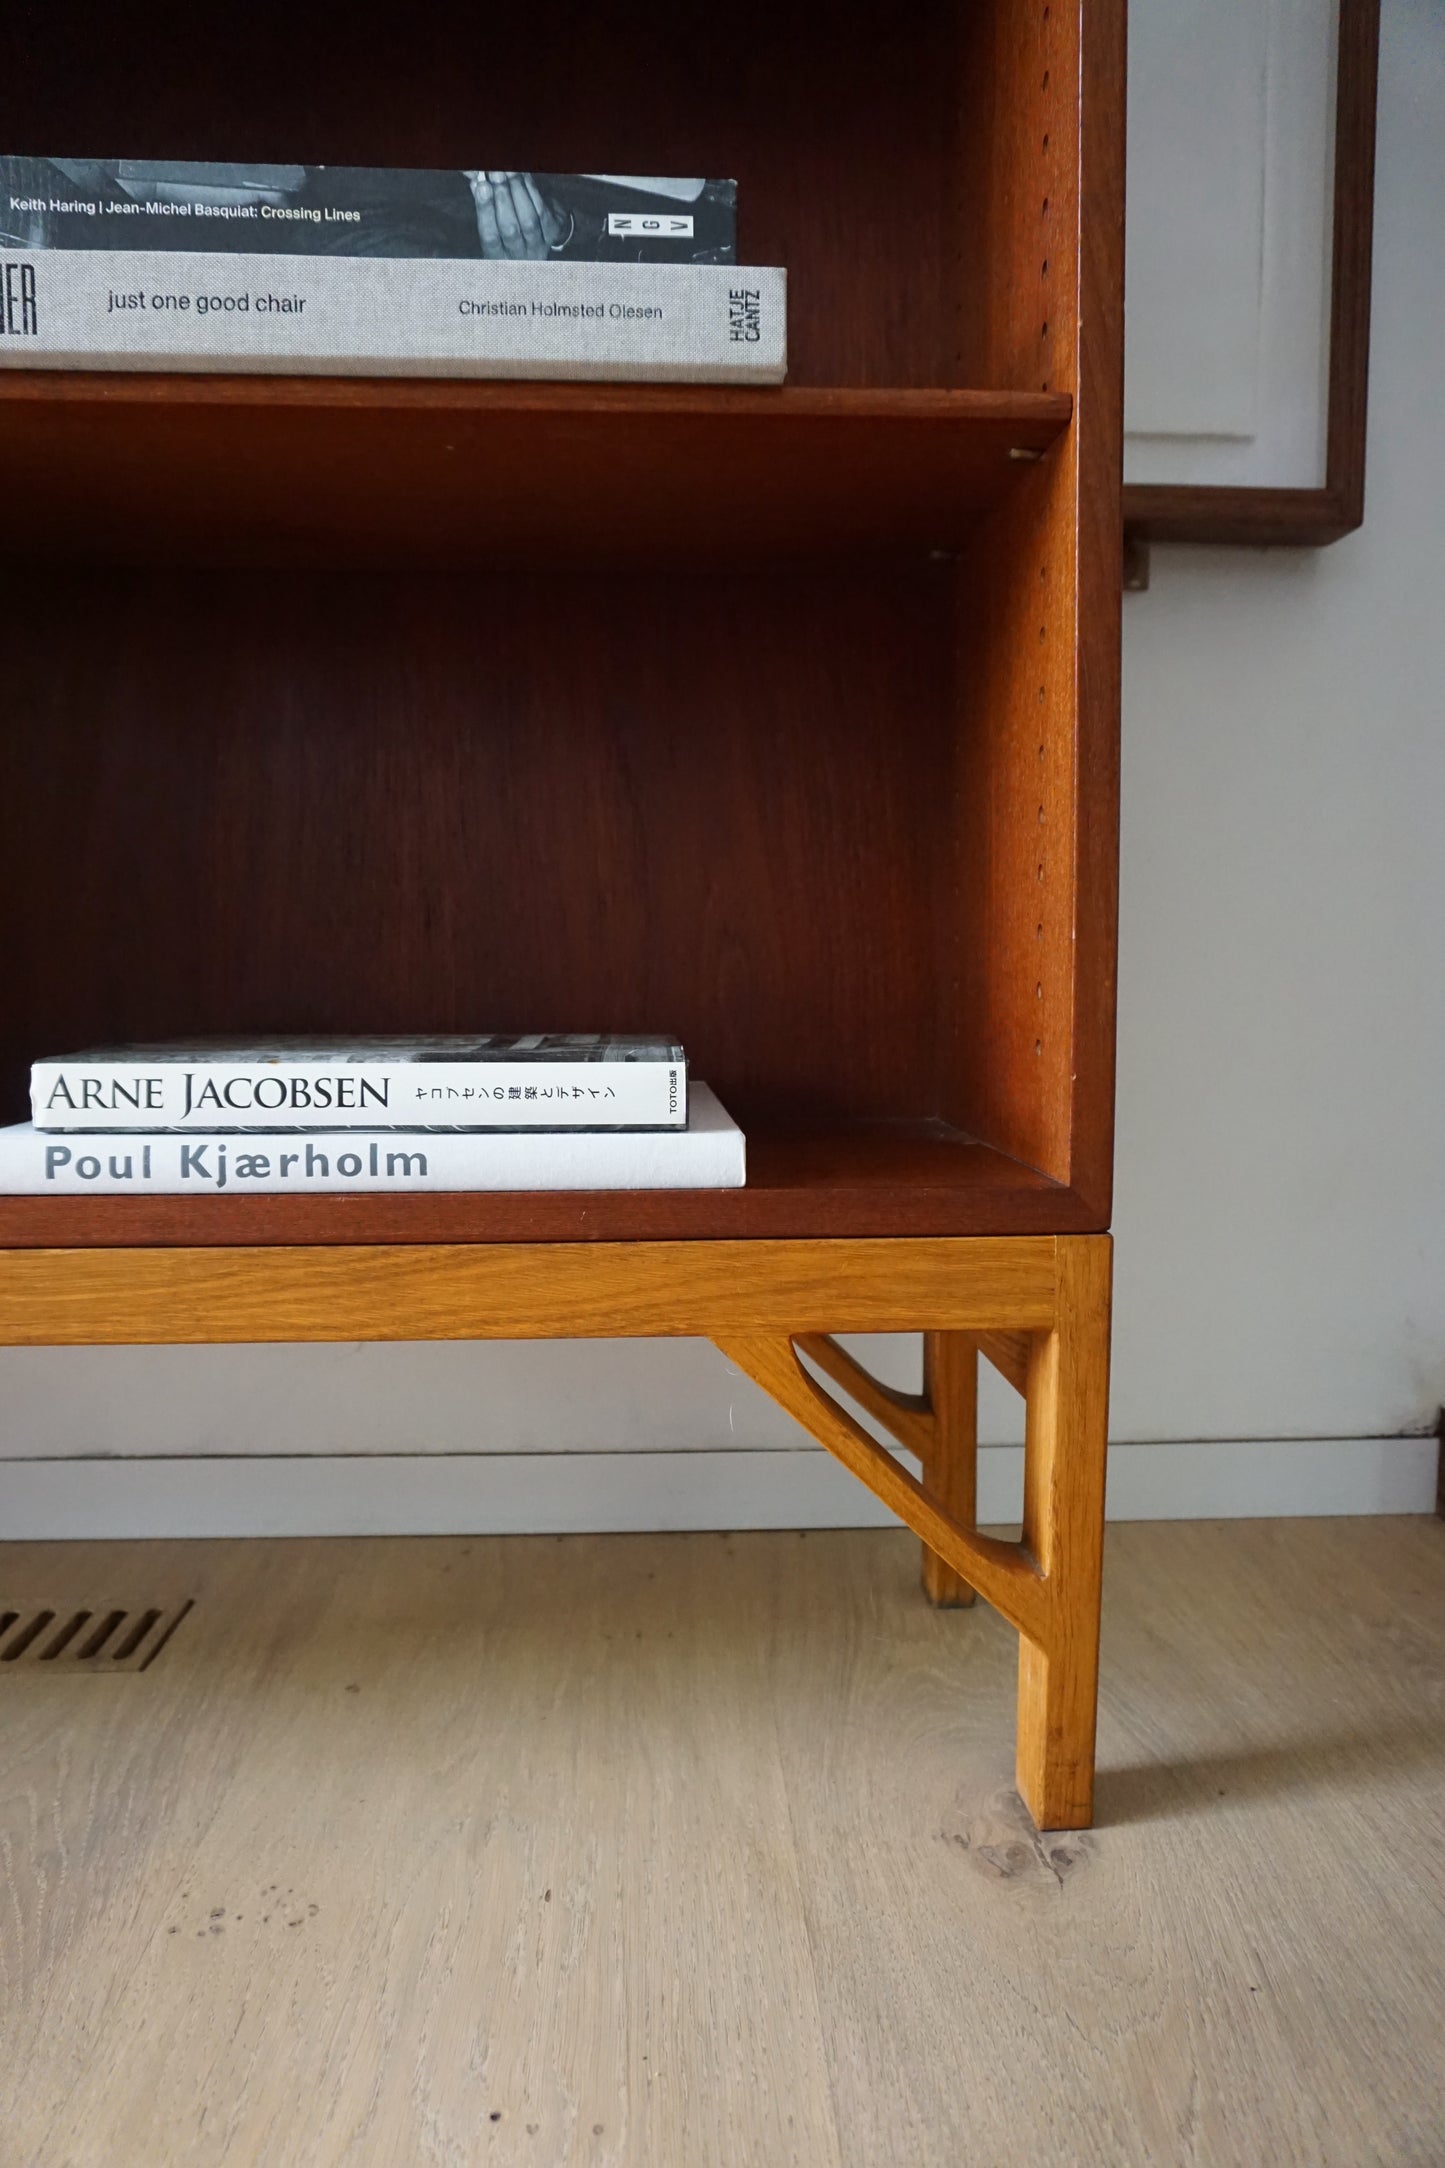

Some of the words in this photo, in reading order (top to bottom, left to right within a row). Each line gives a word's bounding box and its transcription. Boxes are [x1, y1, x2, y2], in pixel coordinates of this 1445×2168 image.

[10, 197, 46, 212] Keith
[50, 199, 96, 216] Haring
[105, 201, 192, 216] Jean-Michel
[194, 203, 258, 219] Basquiat:
[261, 206, 322, 222] Crossing
[324, 208, 361, 222] Lines
[107, 290, 147, 312] just
[151, 295, 192, 311] one
[196, 293, 250, 314] good
[255, 294, 307, 314] chair
[459, 300, 527, 317] Christian
[531, 302, 605, 319] Holmsted
[609, 304, 663, 319] Olesen
[729, 289, 744, 342] HATJE
[744, 289, 761, 343] CANTZ
[45, 1073, 164, 1110] ARNE
[179, 1073, 391, 1120] JACOBSEN
[44, 1144, 152, 1181] Poul
[180, 1142, 428, 1189] Kjærholm
